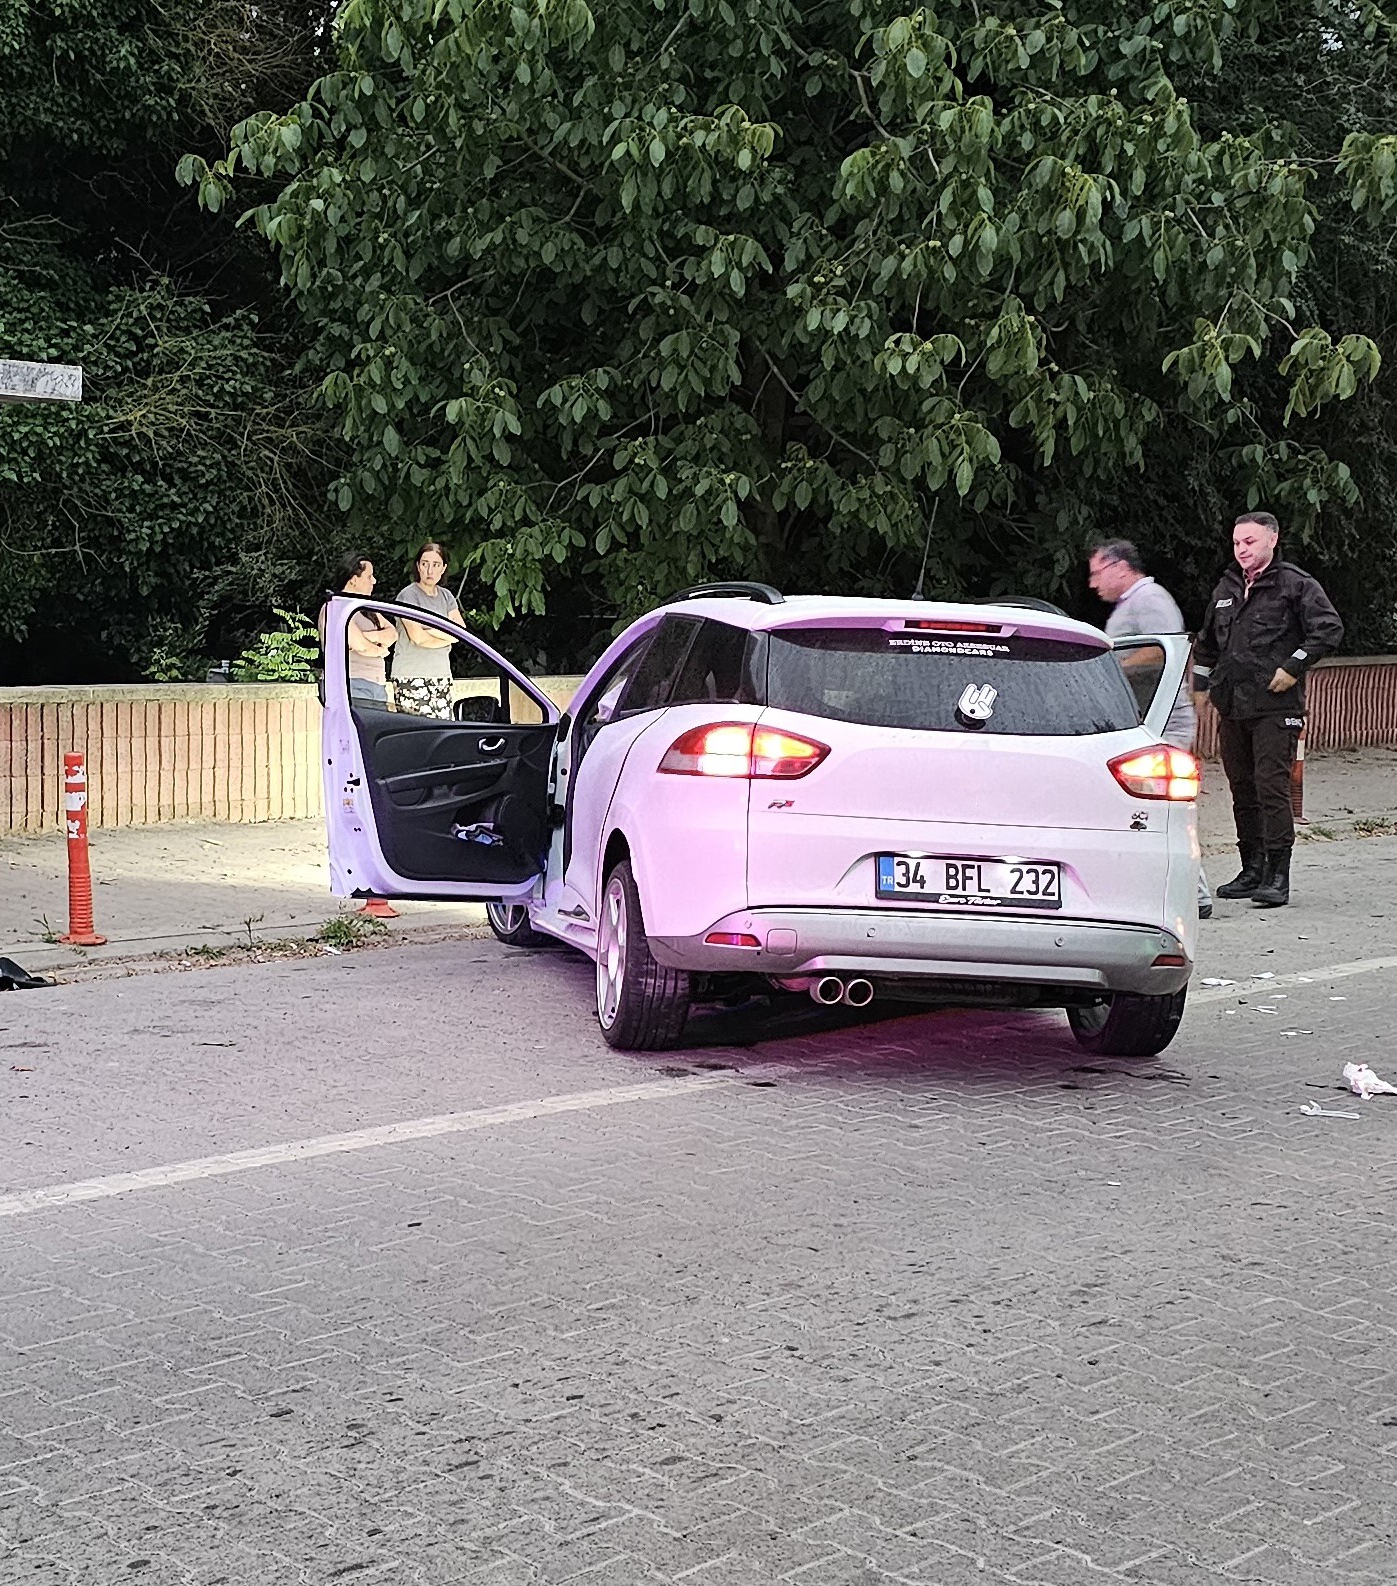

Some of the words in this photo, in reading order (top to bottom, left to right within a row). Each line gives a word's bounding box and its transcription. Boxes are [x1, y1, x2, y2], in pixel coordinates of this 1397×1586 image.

[911, 646, 994, 656] DIAMONDCARS
[881, 875, 894, 885] TR
[895, 860, 927, 890] 34
[945, 862, 991, 893] BFL
[1009, 867, 1056, 897] 232
